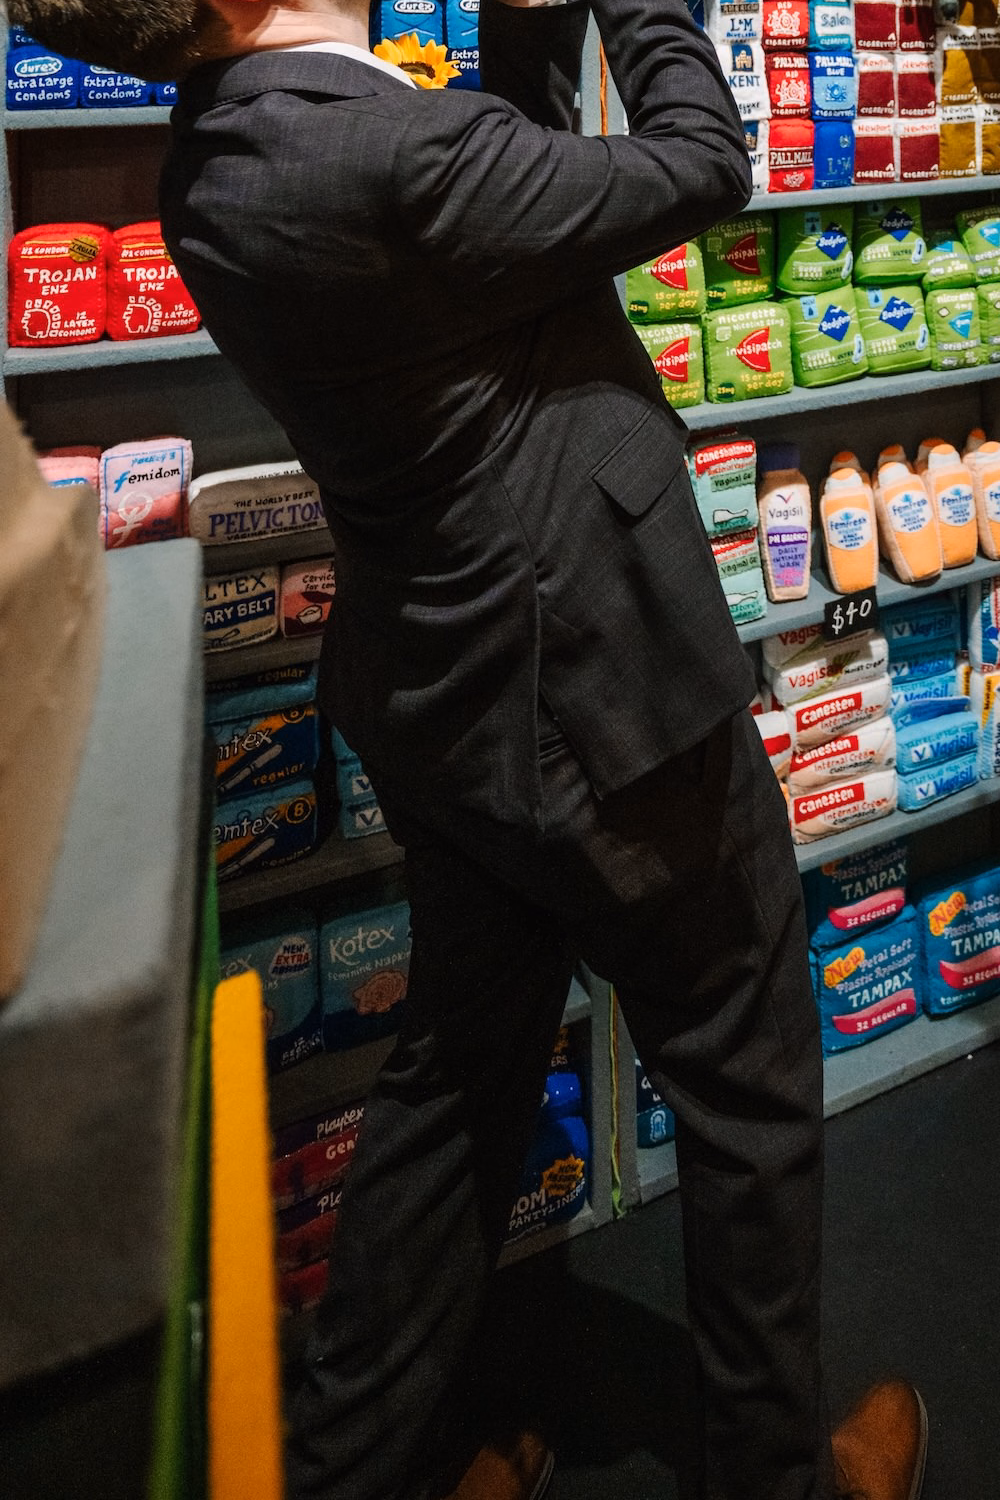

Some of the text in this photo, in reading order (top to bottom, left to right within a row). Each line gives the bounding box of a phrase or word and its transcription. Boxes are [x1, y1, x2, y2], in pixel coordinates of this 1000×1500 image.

[399, 0, 433, 12] durex
[777, 1, 793, 9] RED
[451, 51, 480, 61] Extra
[20, 61, 58, 73] durex
[8, 76, 73, 89] Extra Large
[84, 76, 147, 88] Extra Large
[728, 75, 761, 88] KENT
[15, 90, 71, 101] Condoms
[88, 88, 142, 100] Condoms
[769, 151, 813, 165] PALL MALL
[717, 245, 766, 261] invisipatch
[641, 257, 698, 275] invisipatch
[24, 266, 97, 284] TROJAN
[42, 284, 69, 296] ENZ
[139, 282, 165, 292] ENZ
[659, 299, 697, 311] per day
[76, 311, 87, 320] 12
[161, 316, 198, 327] CONDOMS
[164, 309, 195, 319] LATEX
[718, 308, 777, 325] nicorette
[58, 327, 97, 337] CONDOMS
[64, 319, 96, 328] LATEX
[726, 339, 783, 357] invisipatch
[746, 378, 784, 391] per day
[696, 443, 754, 464] Canesbalance
[234, 499, 252, 508] THE
[292, 490, 315, 501] BEST
[208, 506, 284, 538] PELVIC
[768, 506, 804, 521] Vagisil
[227, 529, 269, 541] VAGINAL
[237, 597, 273, 617] BELT
[831, 599, 872, 635] $40
[256, 667, 306, 684] regular
[801, 697, 855, 725] Canesten
[795, 738, 852, 764] Canesten
[929, 732, 975, 758] Vagisil
[253, 762, 306, 787] regular
[933, 765, 974, 792] Vagisil
[841, 860, 908, 901] TAMPAX
[846, 902, 898, 929] 32 REGULAR
[932, 894, 965, 927] New
[329, 924, 395, 966] Kotex
[890, 938, 912, 957] Soft
[276, 954, 310, 965] EXTRA
[825, 949, 864, 983] New
[836, 974, 874, 995] Plastic
[848, 967, 913, 1008] TAMPAX
[962, 975, 974, 986] 32
[856, 1002, 908, 1032] 32 REGULAR
[317, 1107, 364, 1139] Playtex
